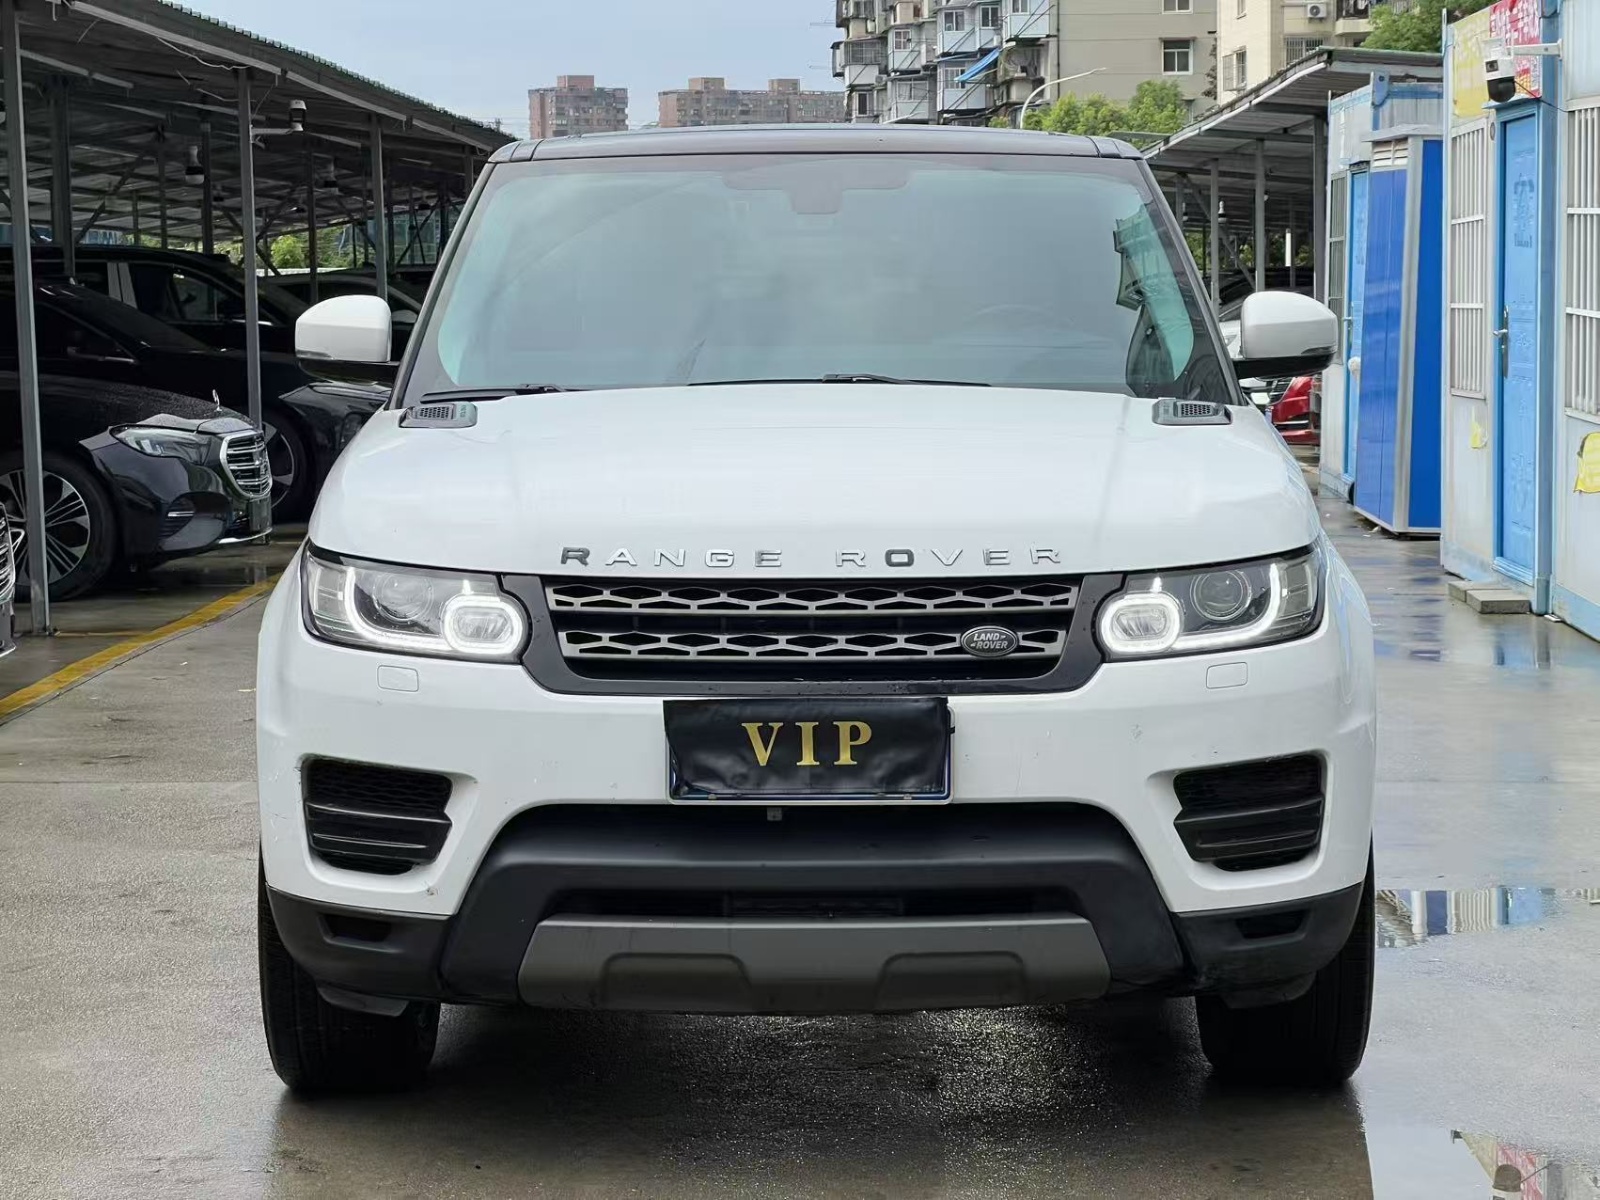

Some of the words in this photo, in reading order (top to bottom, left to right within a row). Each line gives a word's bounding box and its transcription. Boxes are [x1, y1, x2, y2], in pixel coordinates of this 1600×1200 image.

[560, 547, 783, 567] RANGE
[835, 546, 1061, 567] ROVER
[973, 632, 1000, 641] LAND
[975, 640, 1008, 649] ROVER
[741, 720, 873, 767] VIP
